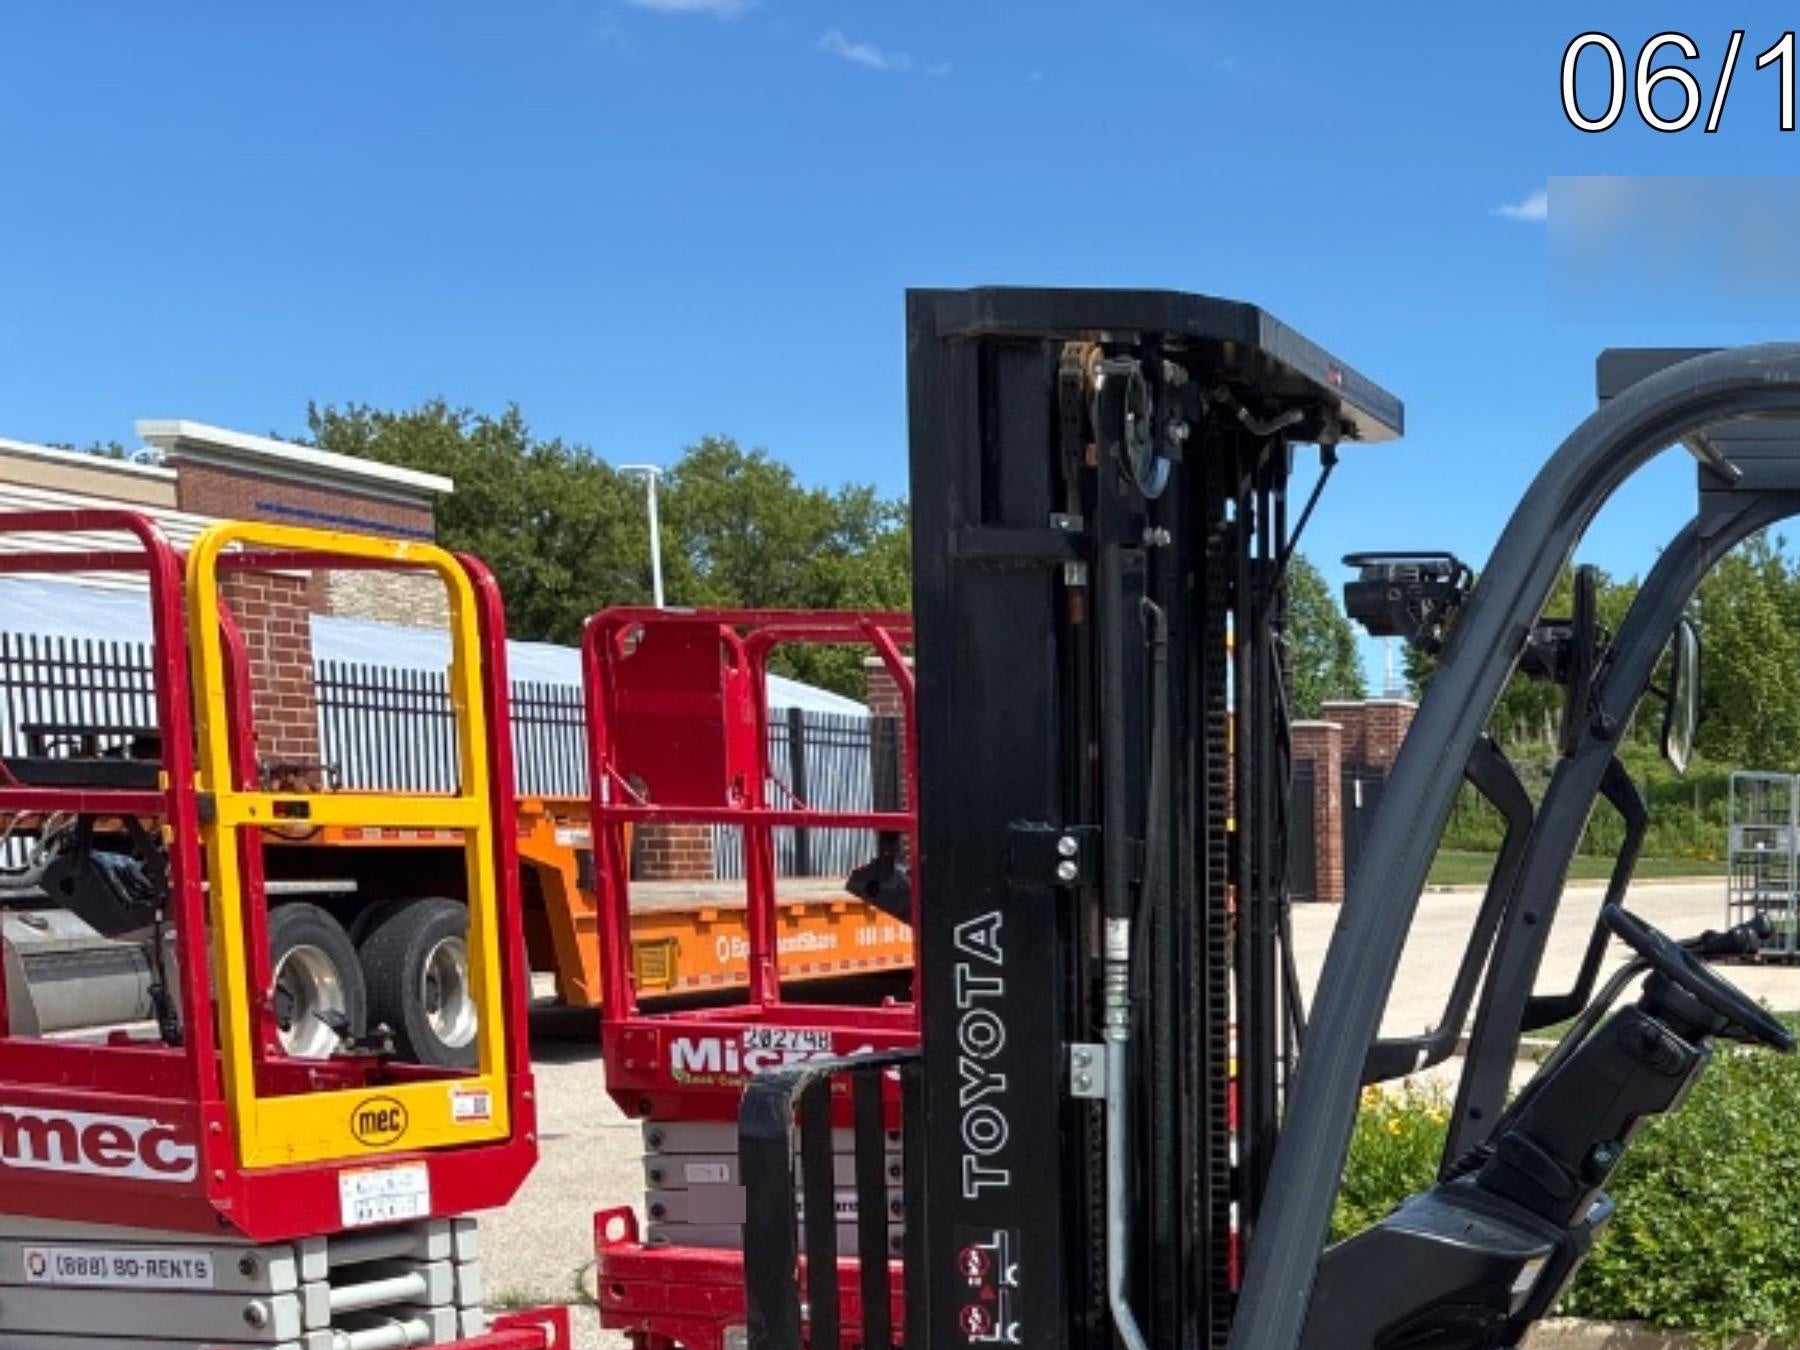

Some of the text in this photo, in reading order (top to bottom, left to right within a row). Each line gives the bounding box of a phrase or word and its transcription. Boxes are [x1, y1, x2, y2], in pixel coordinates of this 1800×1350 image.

[954, 911, 1009, 1198] TOYOTA
[0, 1112, 194, 1173] mec
[358, 1108, 400, 1135] mec
[56, 1255, 208, 1279] (888) 80-RENTS
